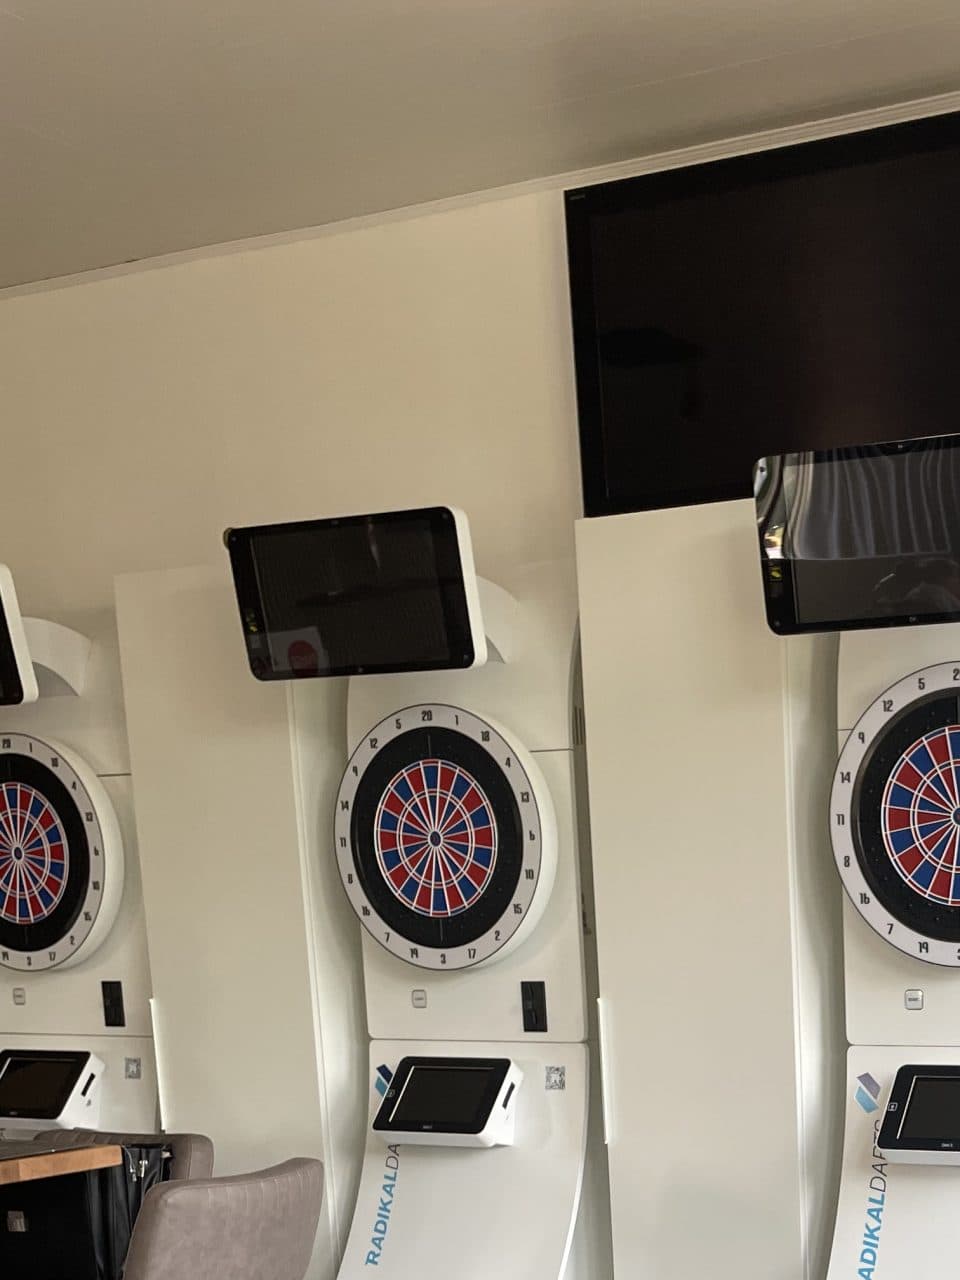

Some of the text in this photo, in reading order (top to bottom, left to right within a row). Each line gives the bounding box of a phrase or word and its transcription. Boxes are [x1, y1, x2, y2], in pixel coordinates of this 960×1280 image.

[917, 677, 926, 691] 5
[882, 699, 894, 713] 12
[857, 731, 865, 745] 9
[839, 771, 851, 784] 14
[835, 813, 845, 826] 11
[843, 855, 851, 868] 8
[859, 892, 871, 905] 16
[886, 922, 894, 935] 7
[917, 941, 929, 954] 19
[364, 1142, 401, 1266] RADIKALDA
